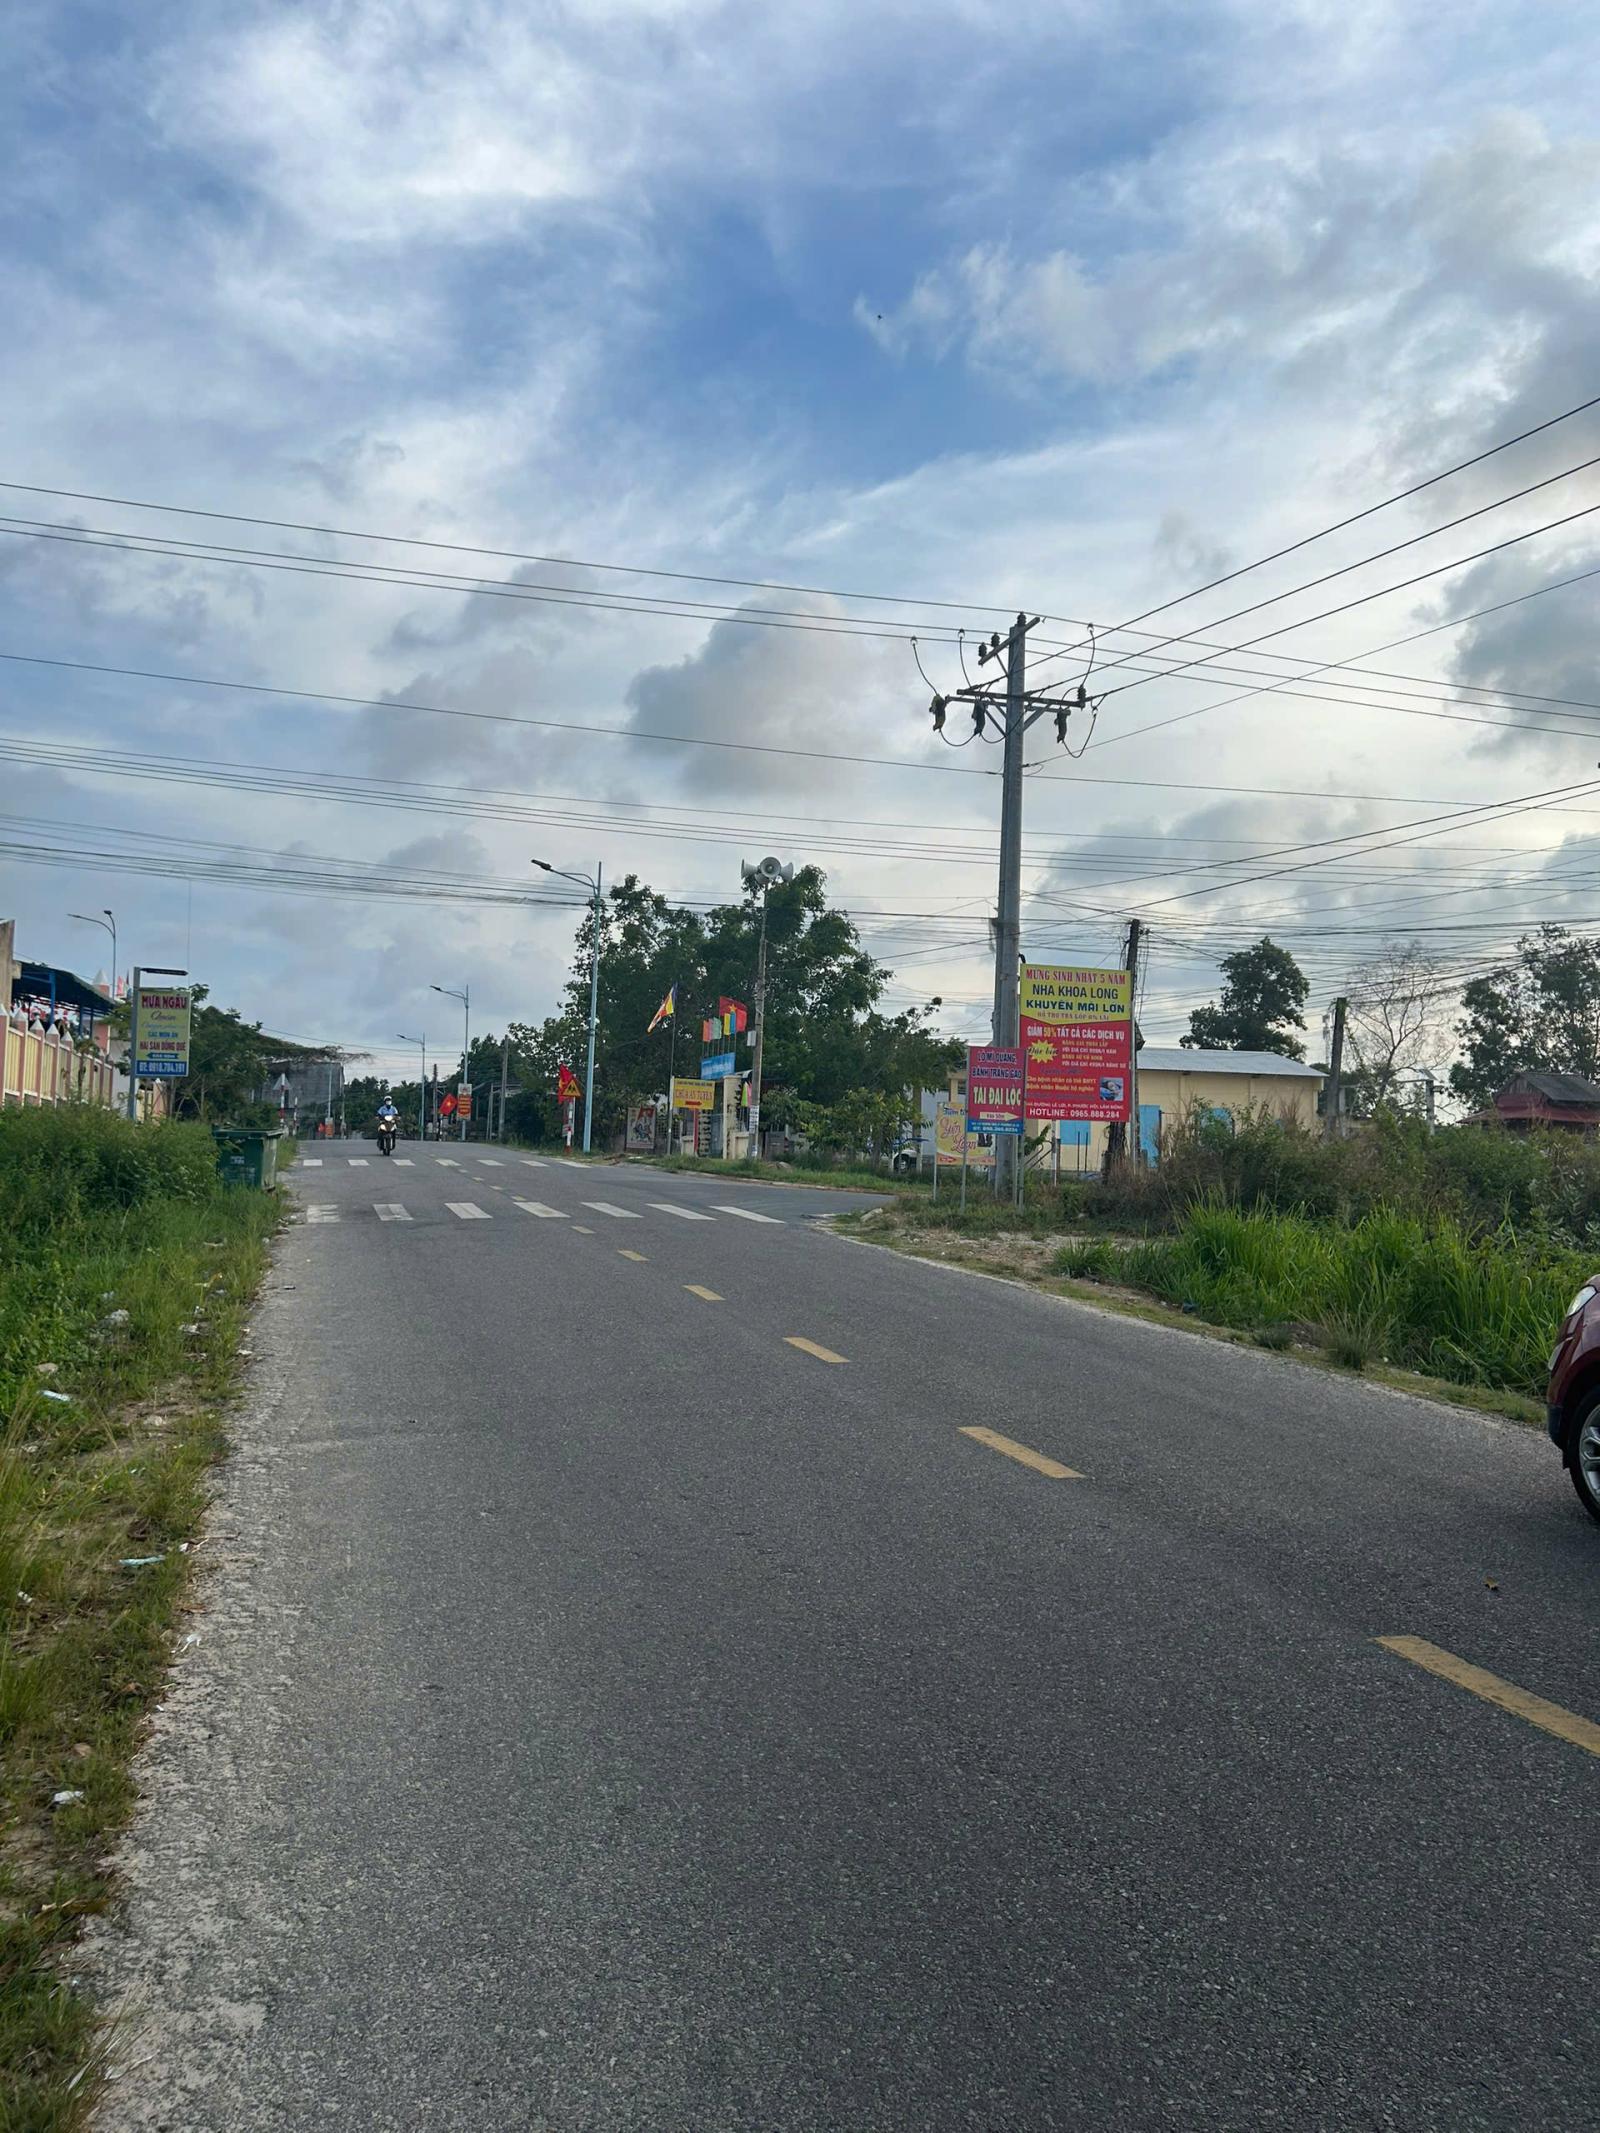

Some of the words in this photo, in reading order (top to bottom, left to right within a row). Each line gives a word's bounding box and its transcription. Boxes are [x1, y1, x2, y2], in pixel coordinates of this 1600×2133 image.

[1053, 970, 1072, 982] SINH
[1100, 973, 1106, 982] 5
[1033, 984, 1054, 996] NHA
[1058, 986, 1087, 998] KHOA
[1091, 988, 1118, 1000] LONG
[1057, 1026, 1070, 1038] TẤT
[1071, 1026, 1080, 1038] CẢ
[1082, 1027, 1096, 1039] CÁC
[1098, 1030, 1114, 1040] DỊCH
[989, 1086, 1003, 1109] ĐẠI
[1030, 1108, 1068, 1116] HOTLINE:
